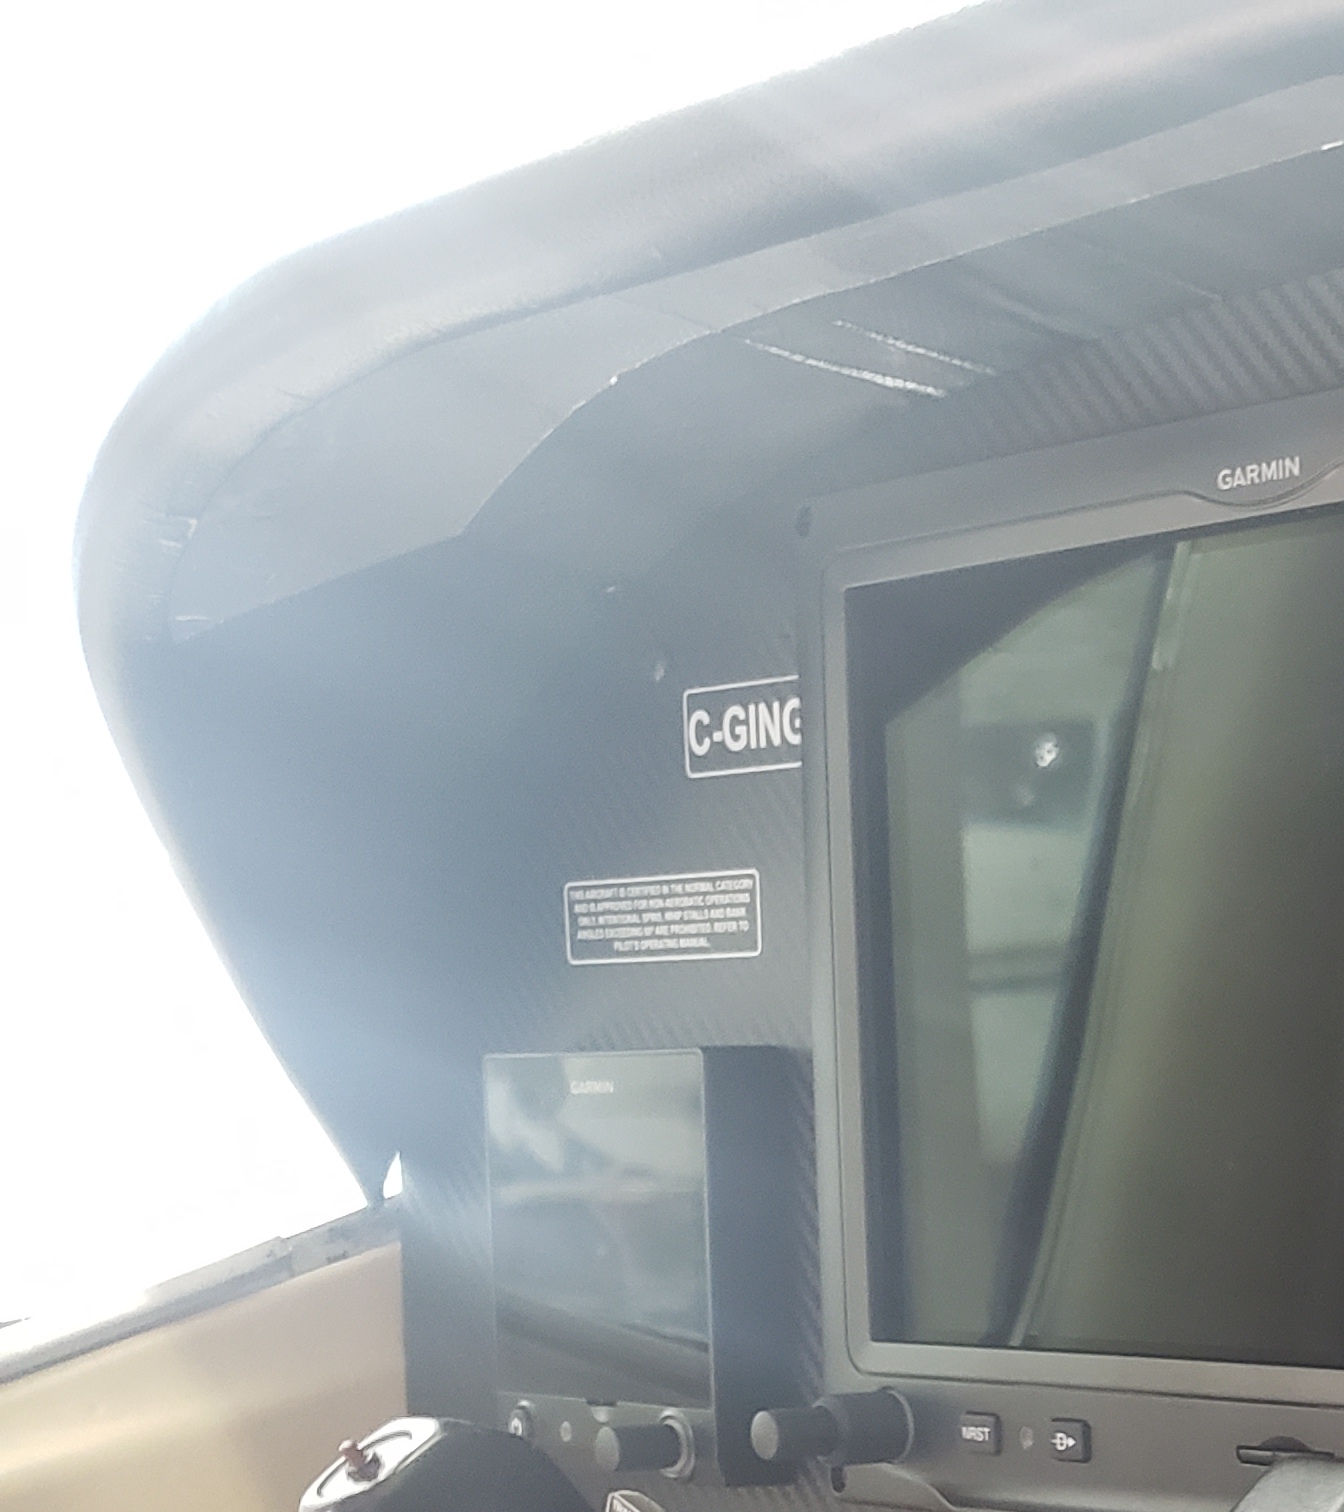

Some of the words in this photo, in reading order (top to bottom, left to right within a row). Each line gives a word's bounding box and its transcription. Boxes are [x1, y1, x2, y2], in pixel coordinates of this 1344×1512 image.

[1216, 456, 1300, 491] GARMIN
[688, 697, 802, 756] C-GING
[570, 1080, 614, 1095] GARMIN
[961, 1426, 991, 1442] NRST
